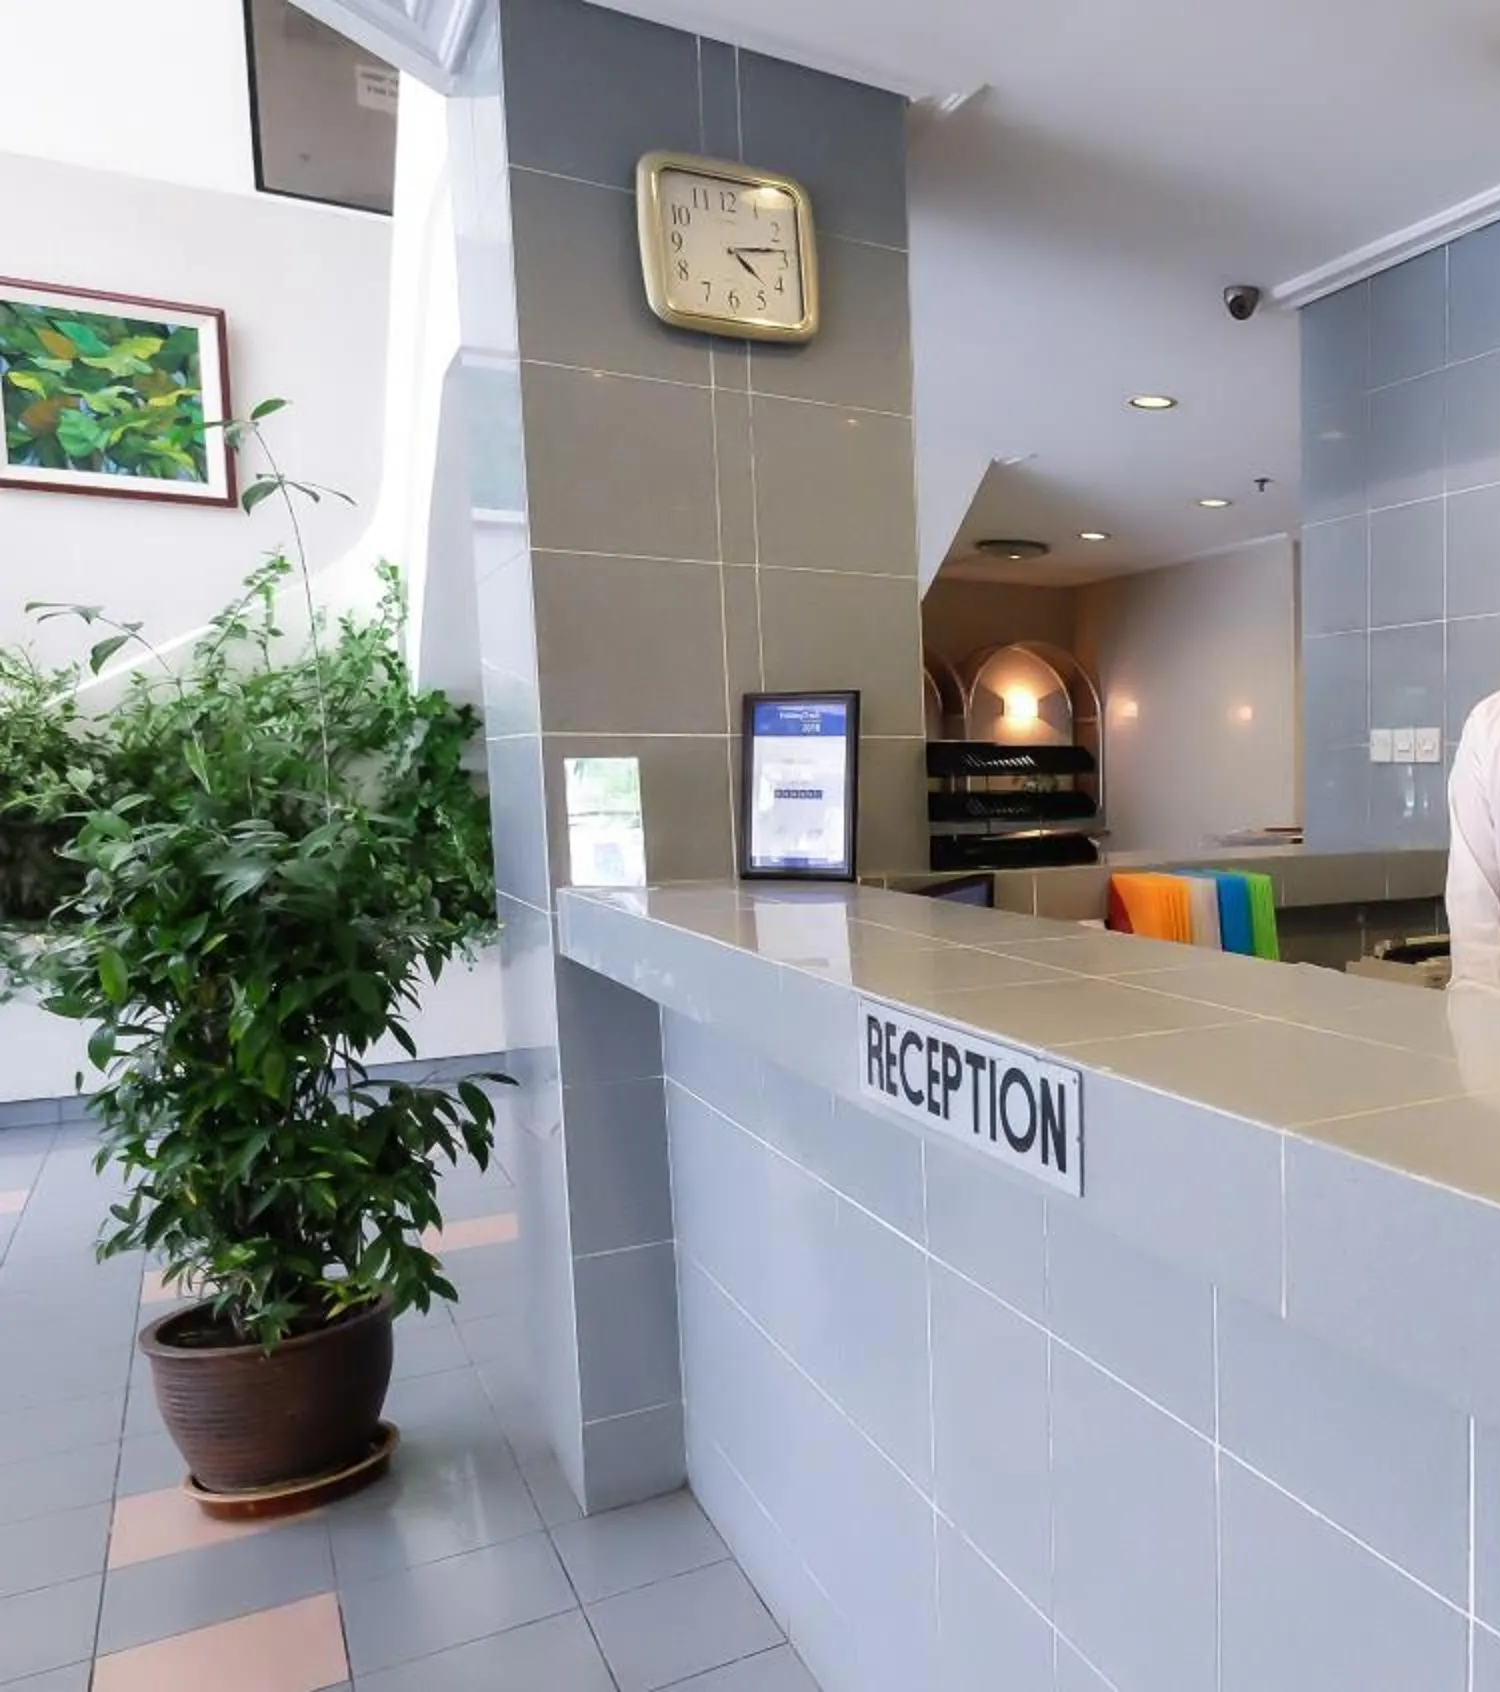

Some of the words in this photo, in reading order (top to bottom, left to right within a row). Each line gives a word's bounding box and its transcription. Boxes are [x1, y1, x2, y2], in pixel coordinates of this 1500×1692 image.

[692, 187, 709, 211] 11
[720, 191, 737, 213] 12
[671, 204, 690, 225] 10
[671, 230, 683, 253] 9
[770, 221, 780, 243] 2
[677, 259, 689, 281] 8
[778, 248, 789, 271] 3
[701, 281, 711, 303] 7
[773, 275, 785, 295] 4
[727, 290, 740, 314] 6
[756, 290, 767, 311] 5
[866, 1014, 1067, 1175] RECEPTION
